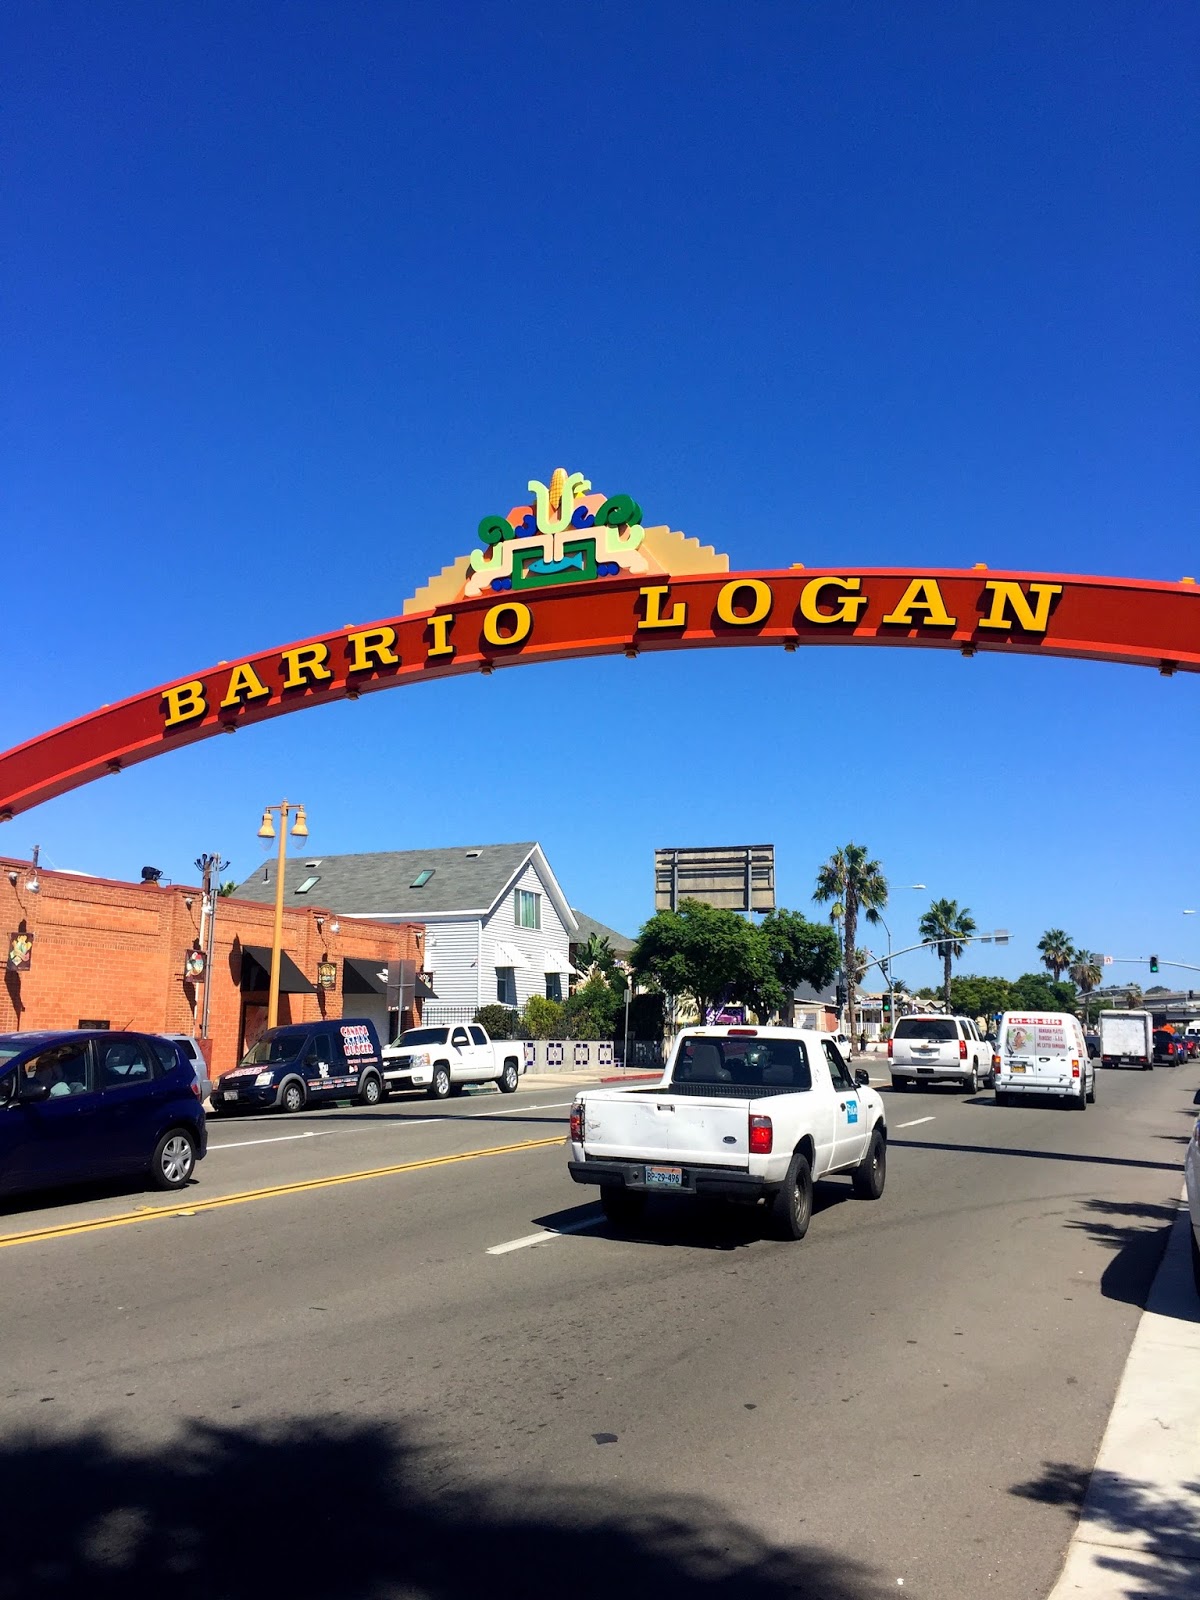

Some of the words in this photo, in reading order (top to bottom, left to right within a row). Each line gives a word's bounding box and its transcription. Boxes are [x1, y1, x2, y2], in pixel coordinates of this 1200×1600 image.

[162, 602, 532, 726] BARRIO
[637, 577, 1063, 633] LOGAN
[340, 1025, 369, 1038] CANADA
[343, 1043, 374, 1056] BURGER
